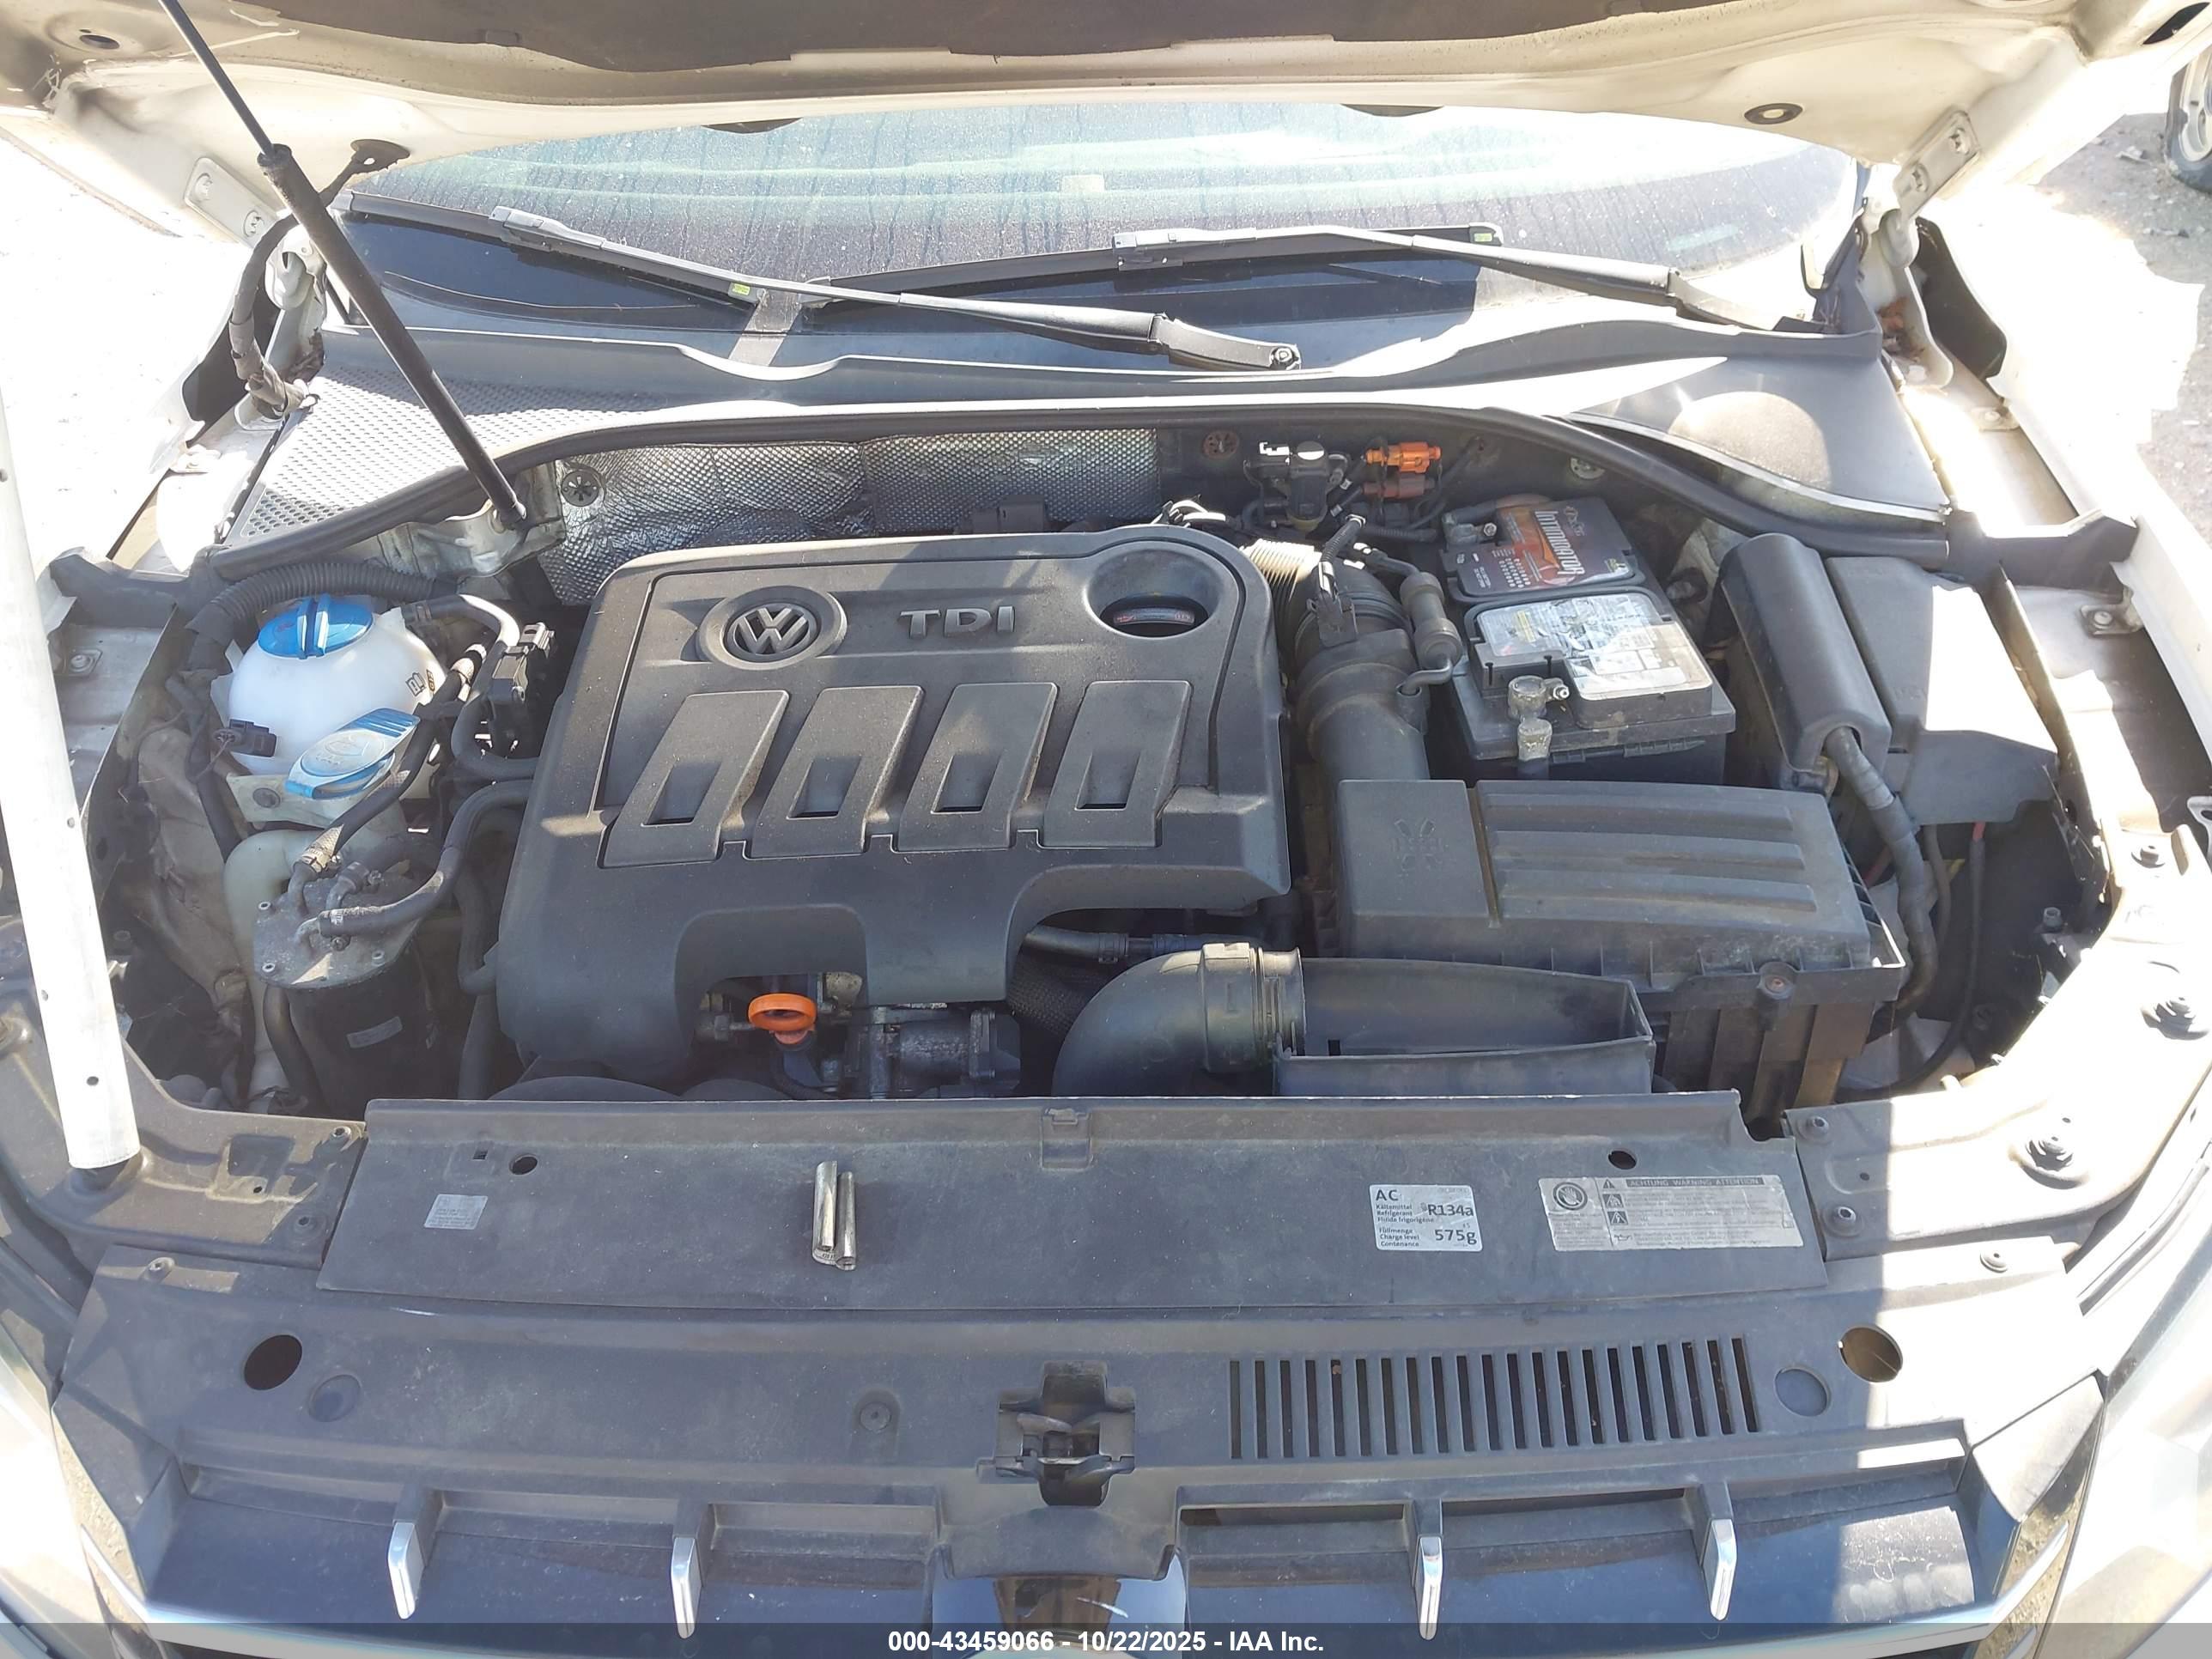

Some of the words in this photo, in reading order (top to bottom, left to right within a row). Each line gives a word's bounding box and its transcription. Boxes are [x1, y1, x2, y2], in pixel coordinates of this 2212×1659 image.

[900, 605, 1016, 639] TDI
[1376, 1189, 1399, 1201] AC
[1427, 1204, 1474, 1217] R134a
[1435, 1229, 1478, 1245] 575g
